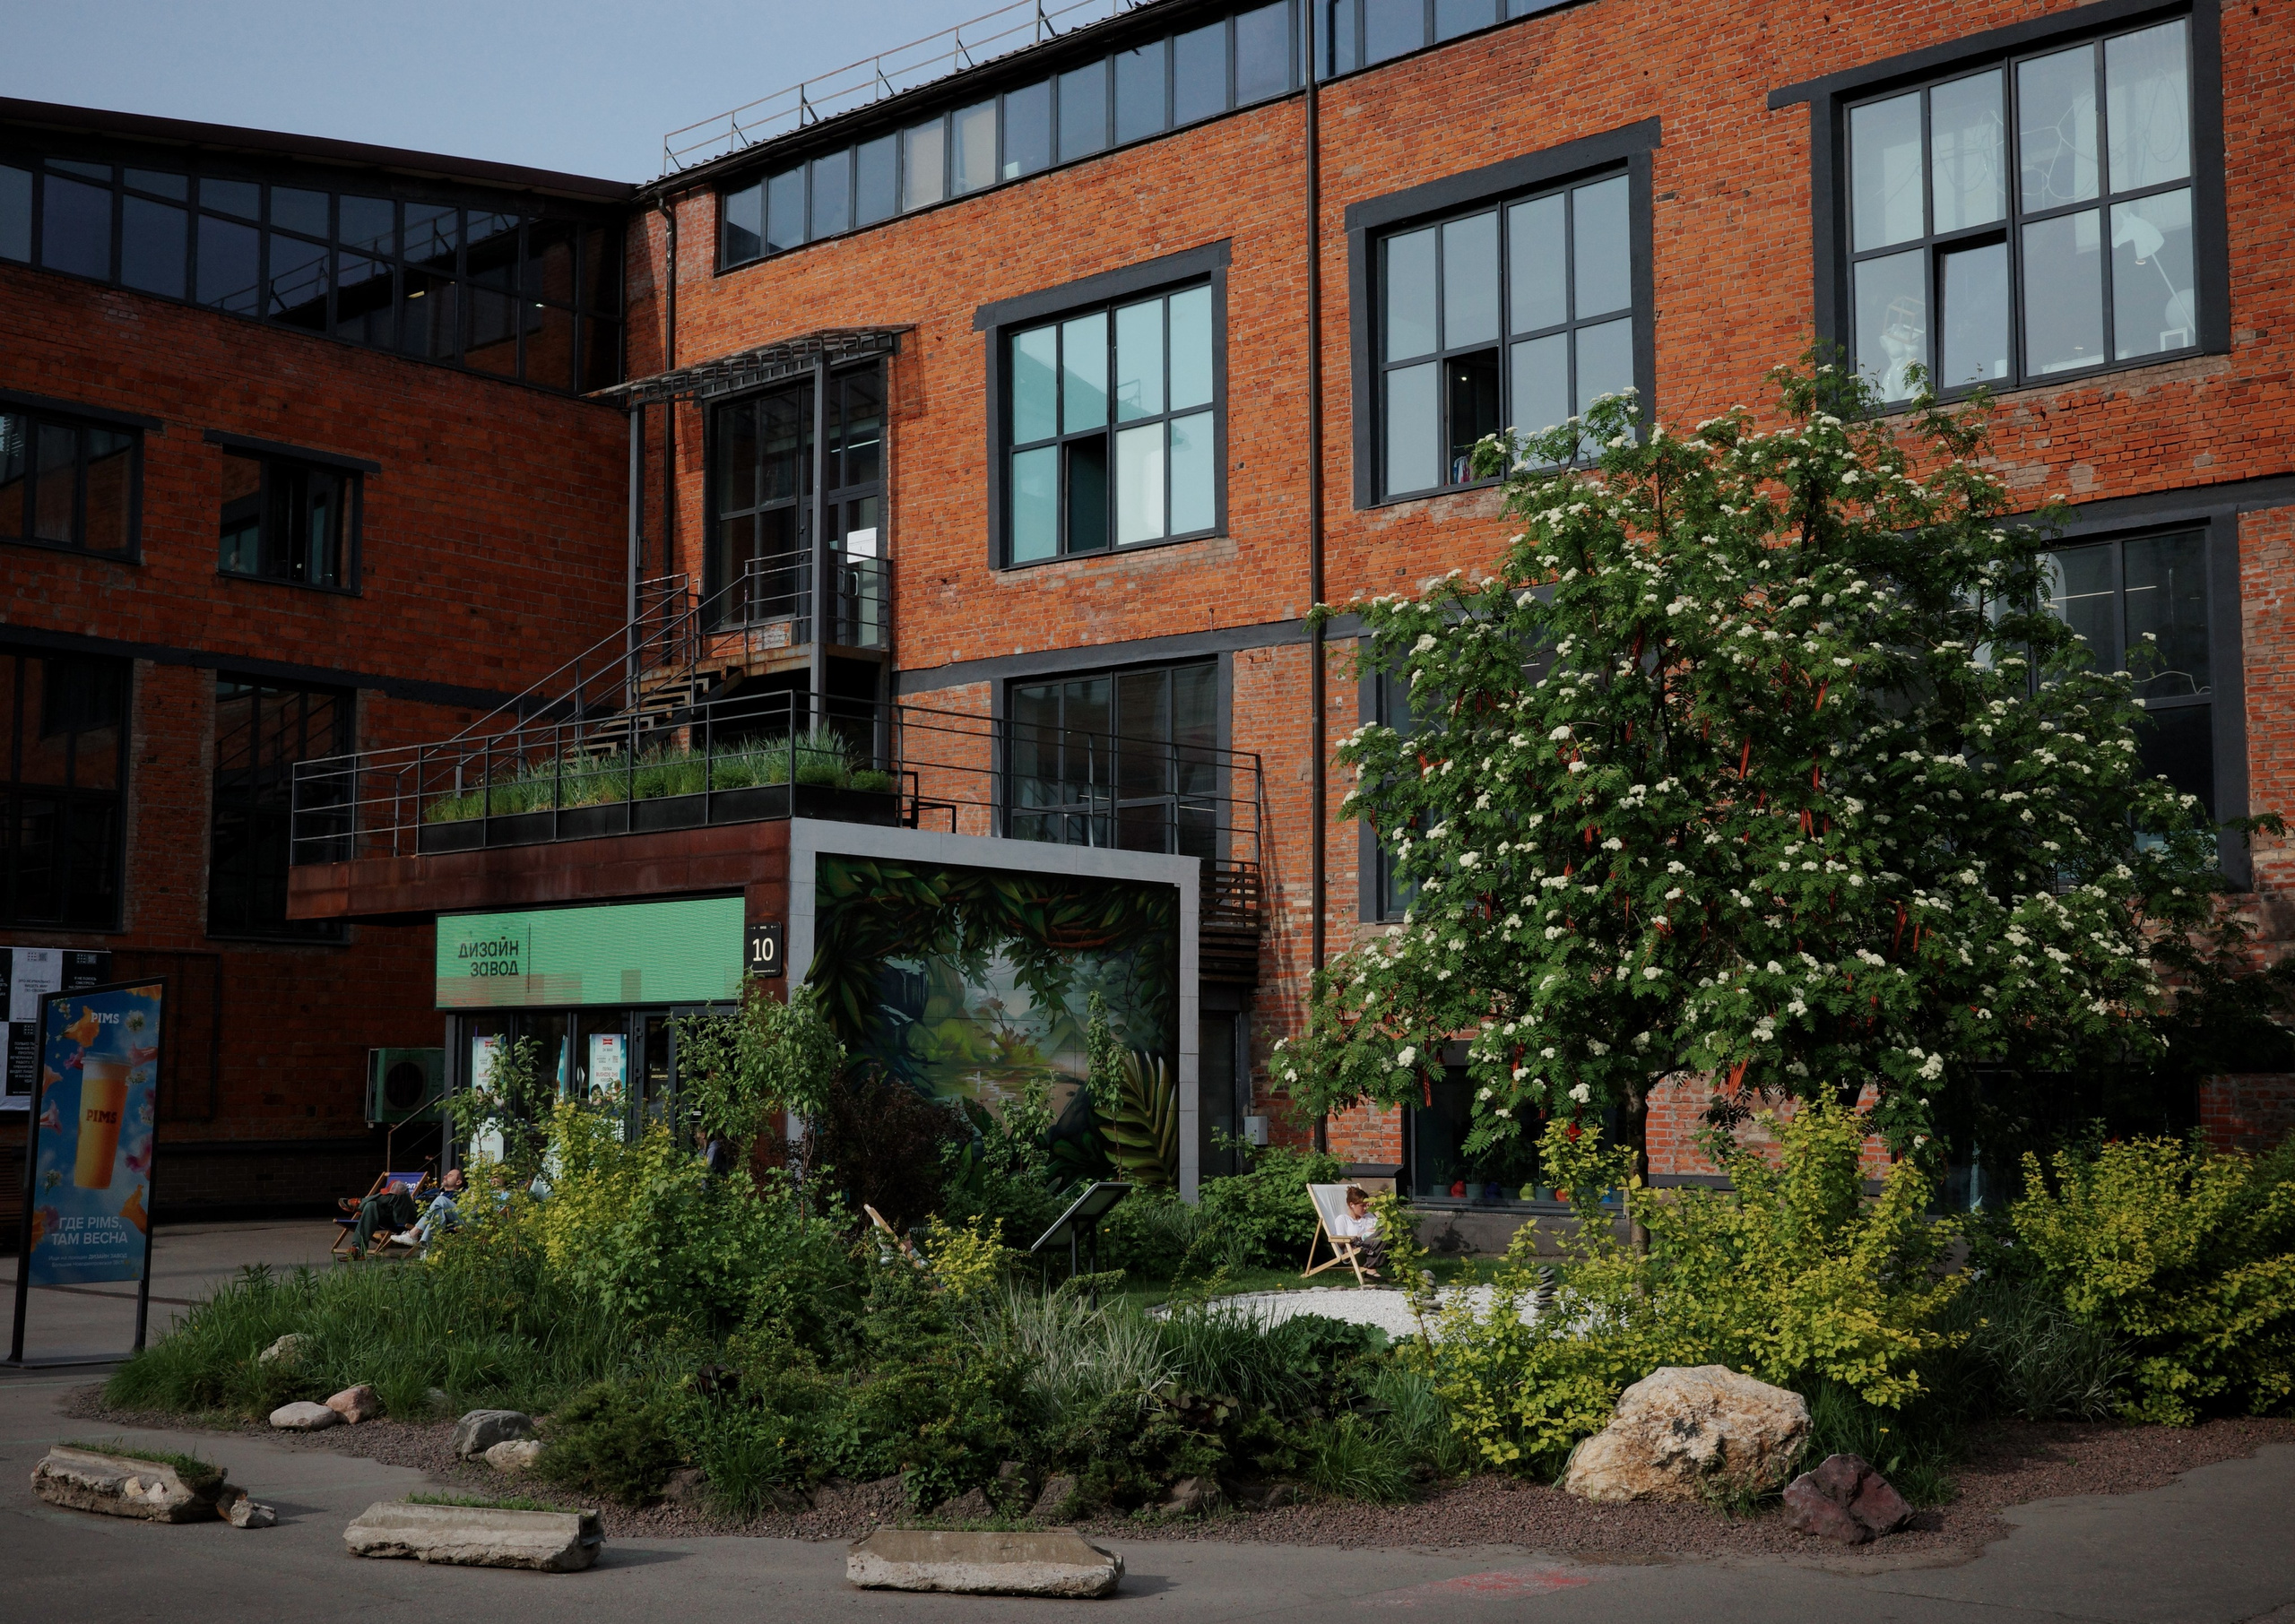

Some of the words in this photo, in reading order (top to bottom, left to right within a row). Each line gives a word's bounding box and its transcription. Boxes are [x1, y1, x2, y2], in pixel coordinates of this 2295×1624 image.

[752, 937, 774, 962] 10
[91, 1012, 119, 1024] PIMS
[86, 1109, 117, 1124] PIMS
[59, 1217, 84, 1231] ГДЕ
[88, 1216, 122, 1230] PIMS,
[51, 1232, 79, 1246] ТАМ
[83, 1231, 128, 1245] ВЕСНА
